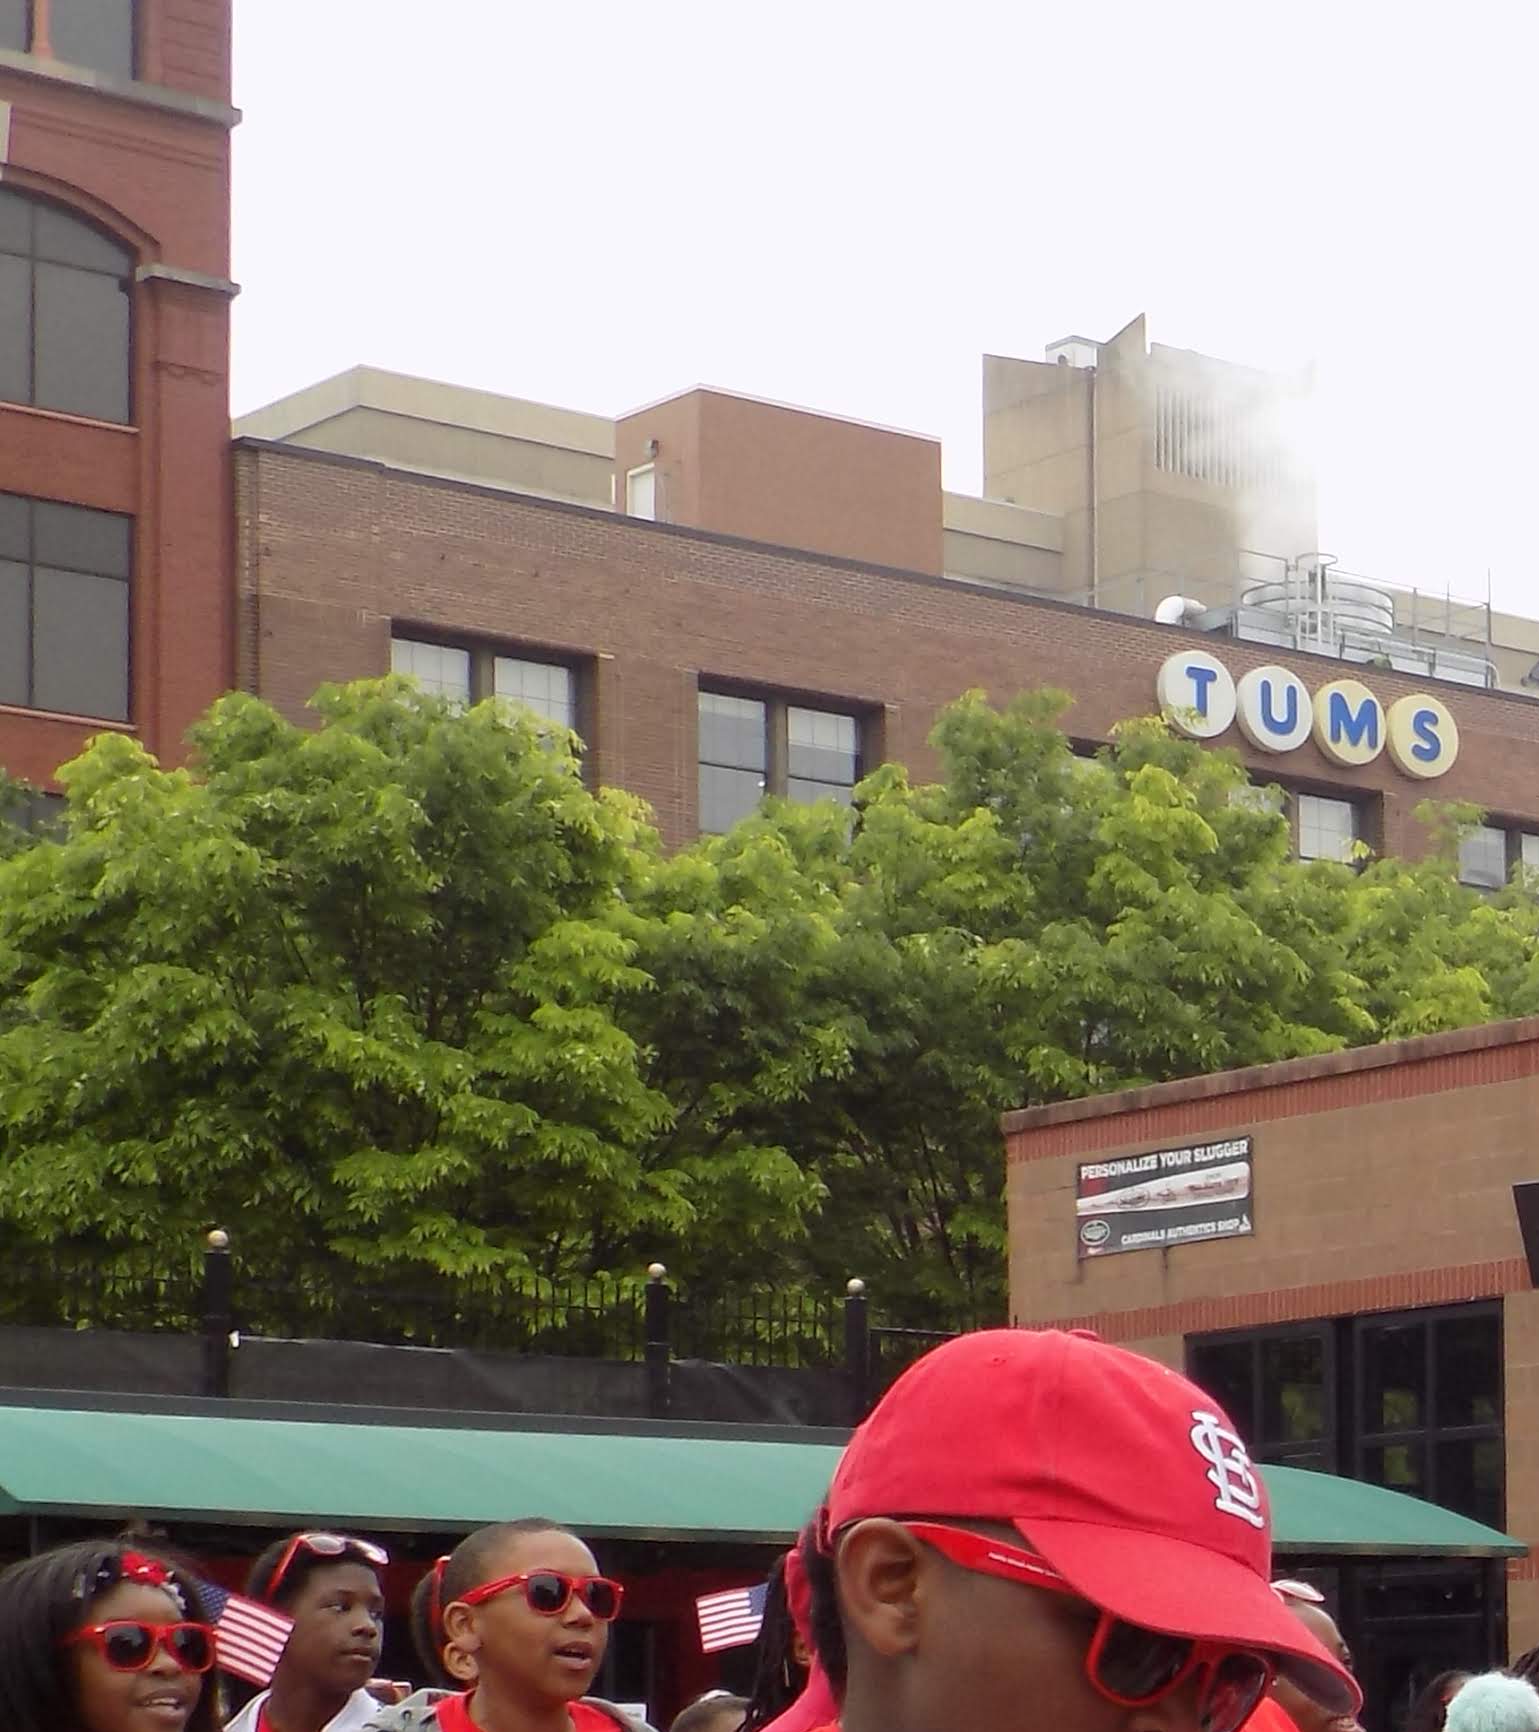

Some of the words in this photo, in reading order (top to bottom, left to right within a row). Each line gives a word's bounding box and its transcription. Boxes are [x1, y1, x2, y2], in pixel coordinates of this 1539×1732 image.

[1185, 665, 1441, 763] TUMS
[1081, 1153, 1158, 1180] PERSONALIZE
[1159, 1149, 1193, 1168] YOUR
[1193, 1139, 1248, 1163] SLUGGER
